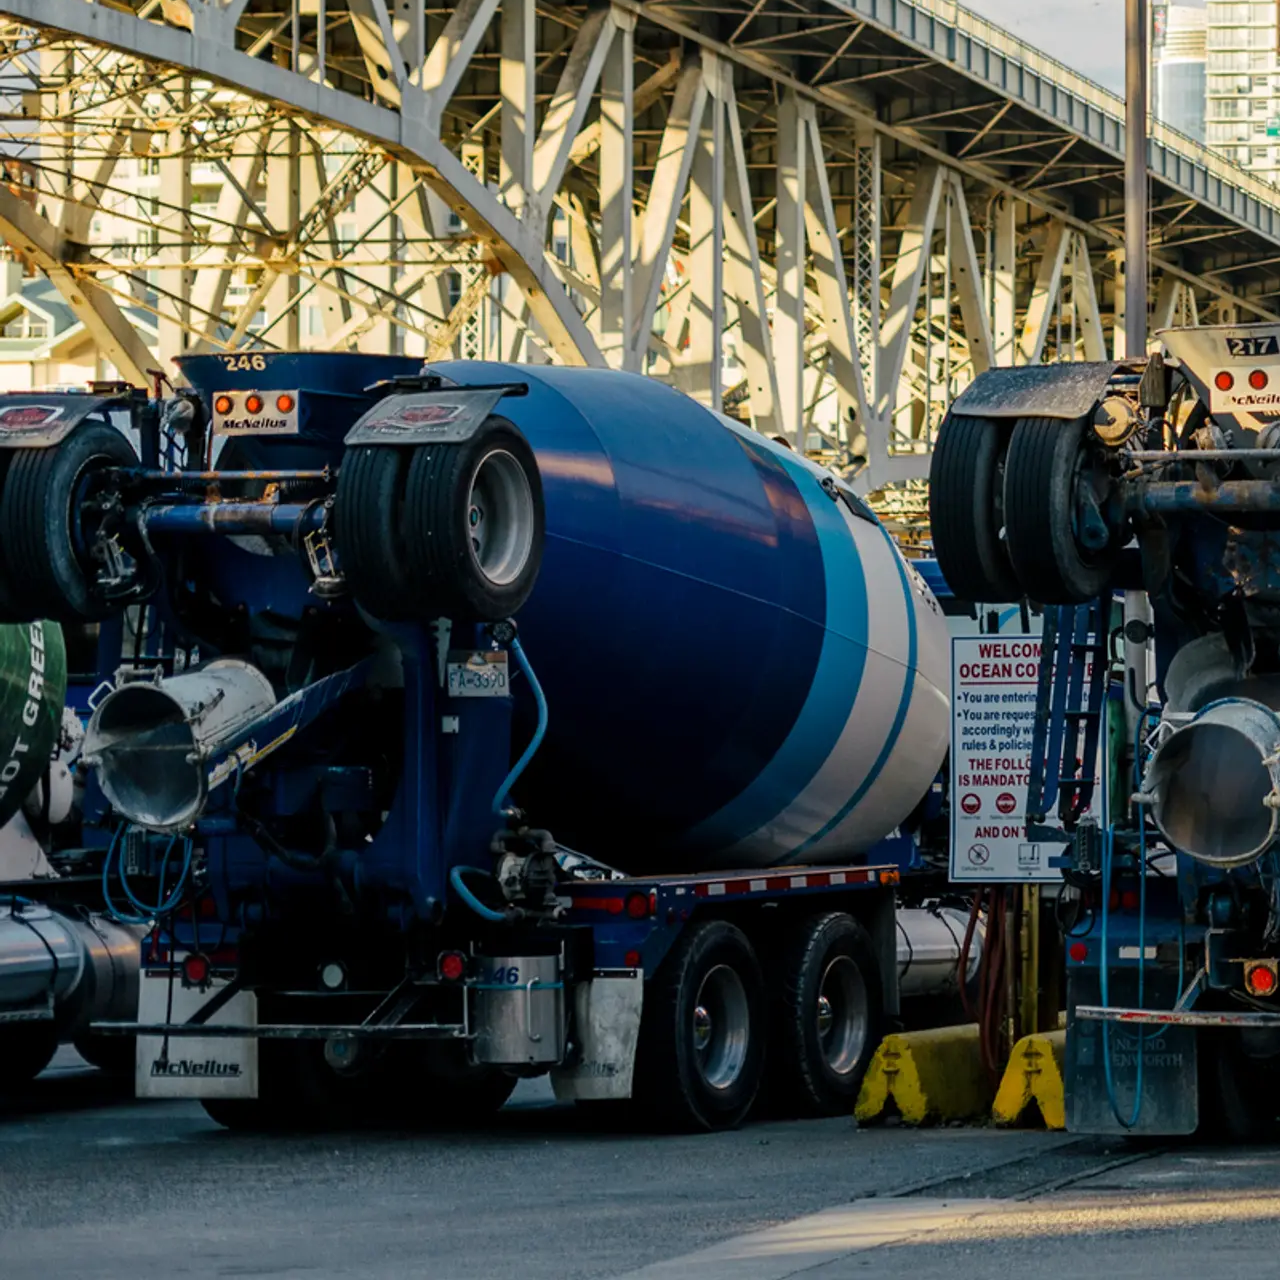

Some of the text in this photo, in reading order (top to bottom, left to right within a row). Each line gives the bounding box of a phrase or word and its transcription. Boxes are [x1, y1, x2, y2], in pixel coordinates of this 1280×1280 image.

[1232, 339, 1270, 355] 217
[224, 355, 266, 371] 246
[223, 418, 287, 429] McNeilus
[959, 663, 1012, 678] OCEAN
[963, 691, 981, 703] You
[984, 694, 999, 703] are
[963, 709, 981, 721] You
[984, 711, 999, 720] are
[962, 725, 1020, 738] accordingly
[962, 740, 987, 750] rules
[989, 739, 996, 750] &
[968, 758, 993, 770] THE
[959, 775, 970, 786] IS
[975, 827, 999, 838] AND
[1002, 826, 1019, 837] ON
